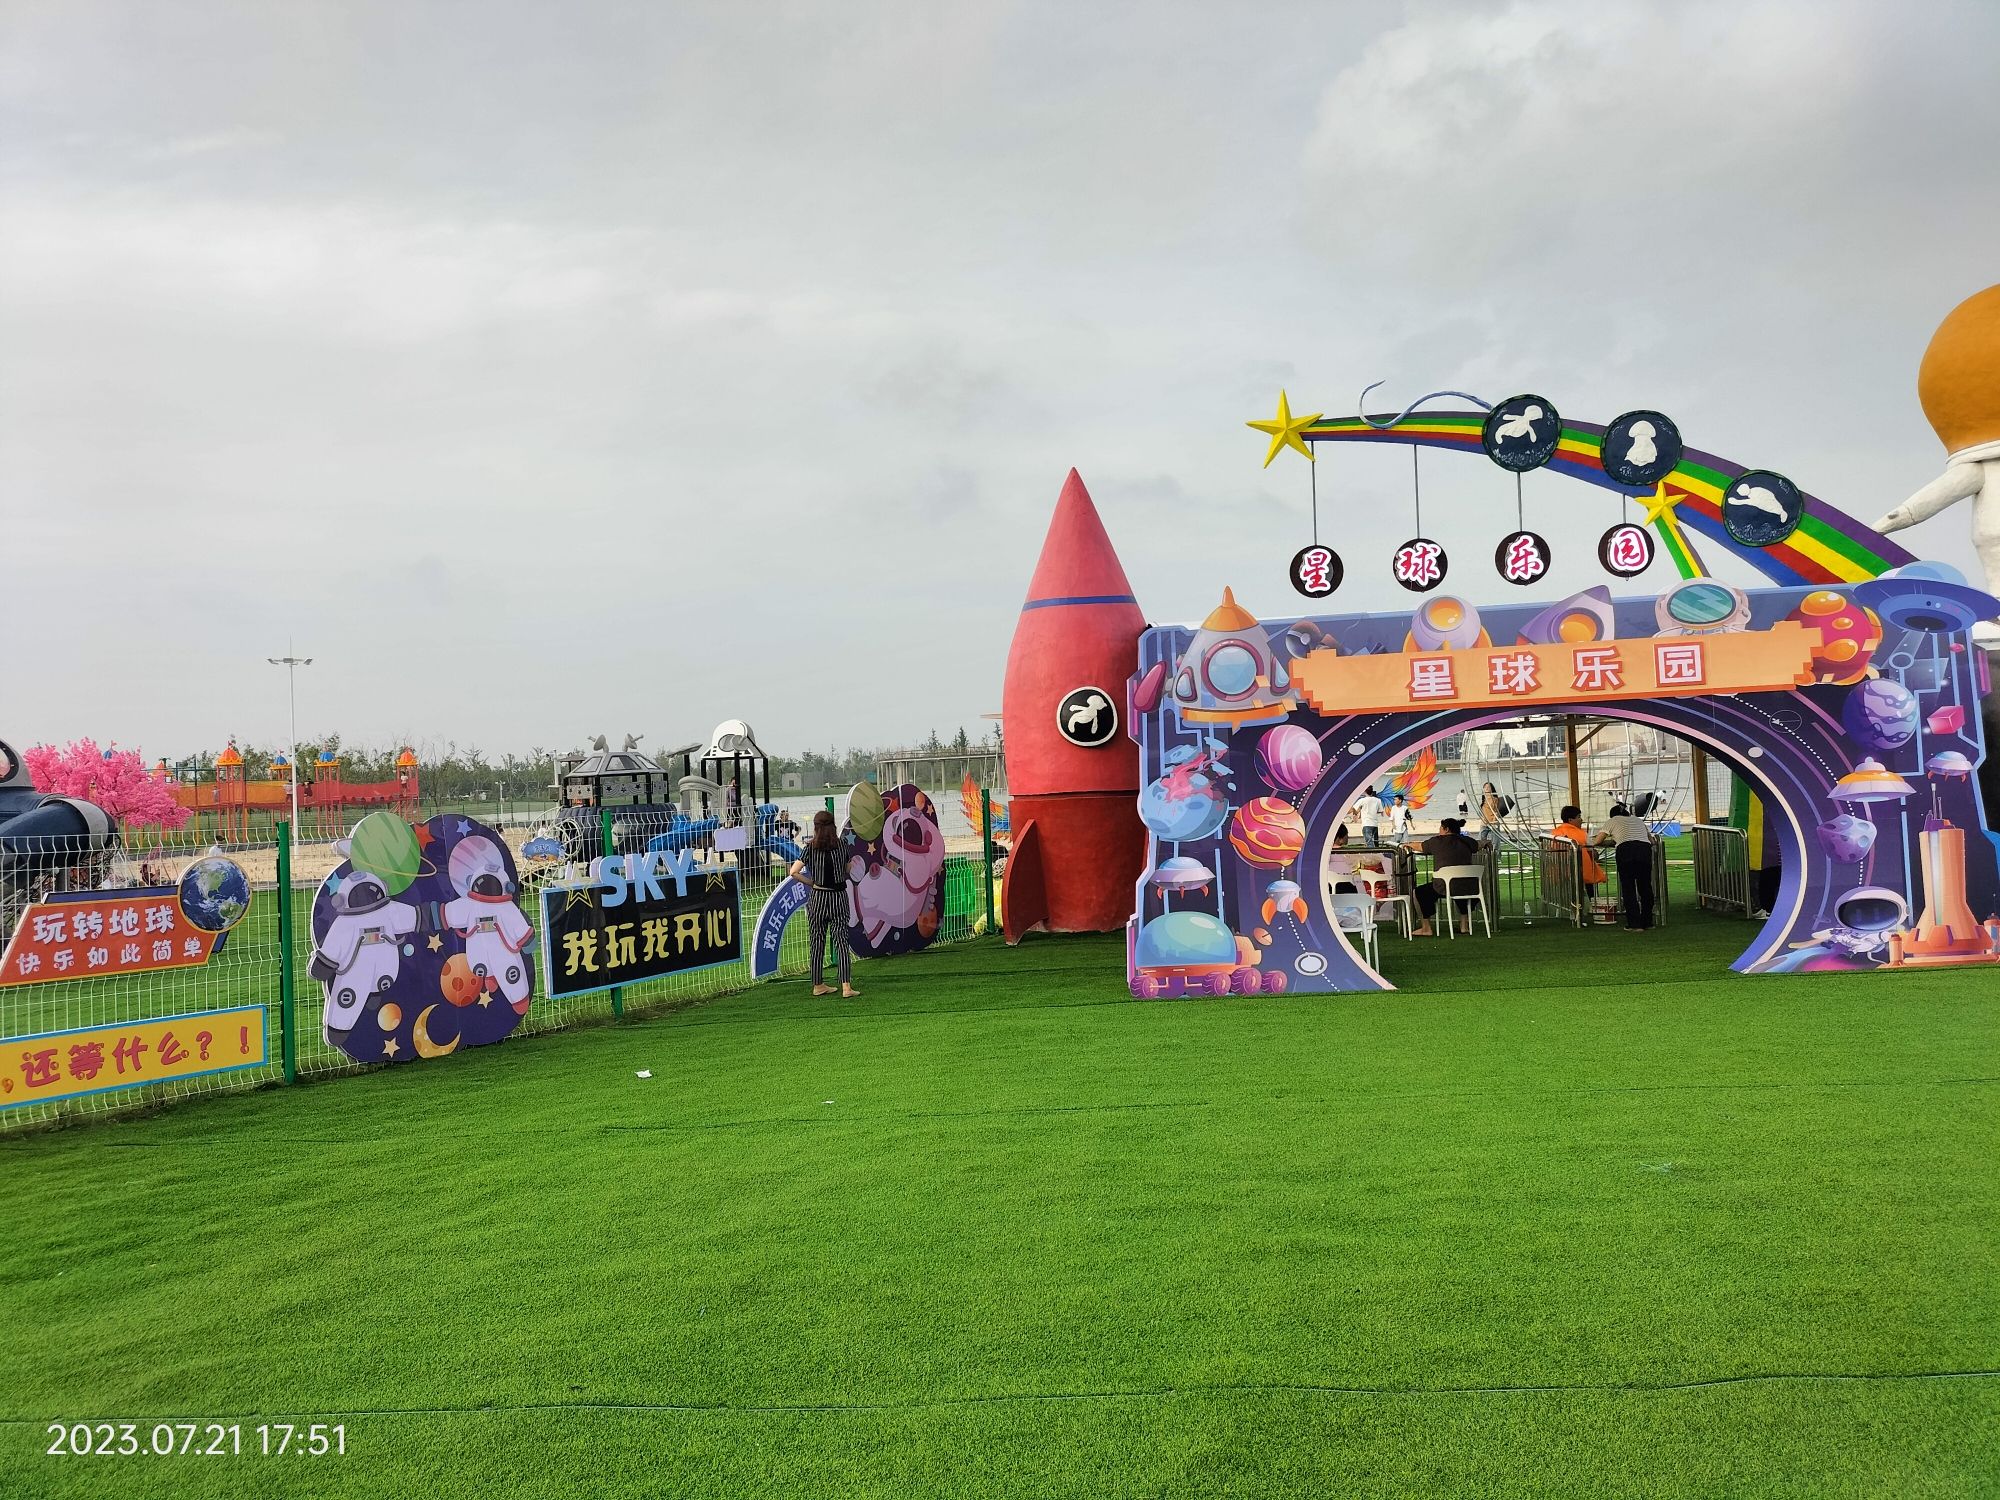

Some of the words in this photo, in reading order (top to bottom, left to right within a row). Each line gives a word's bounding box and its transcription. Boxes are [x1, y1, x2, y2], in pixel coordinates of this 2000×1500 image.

[1301, 527, 1648, 592] 星球乐园
[1407, 641, 1706, 701] 星球乐园
[599, 849, 694, 908] SKY
[32, 904, 176, 945] 玩转地球
[562, 907, 732, 976] 我玩我开心
[15, 936, 203, 975] 快乐如此简单
